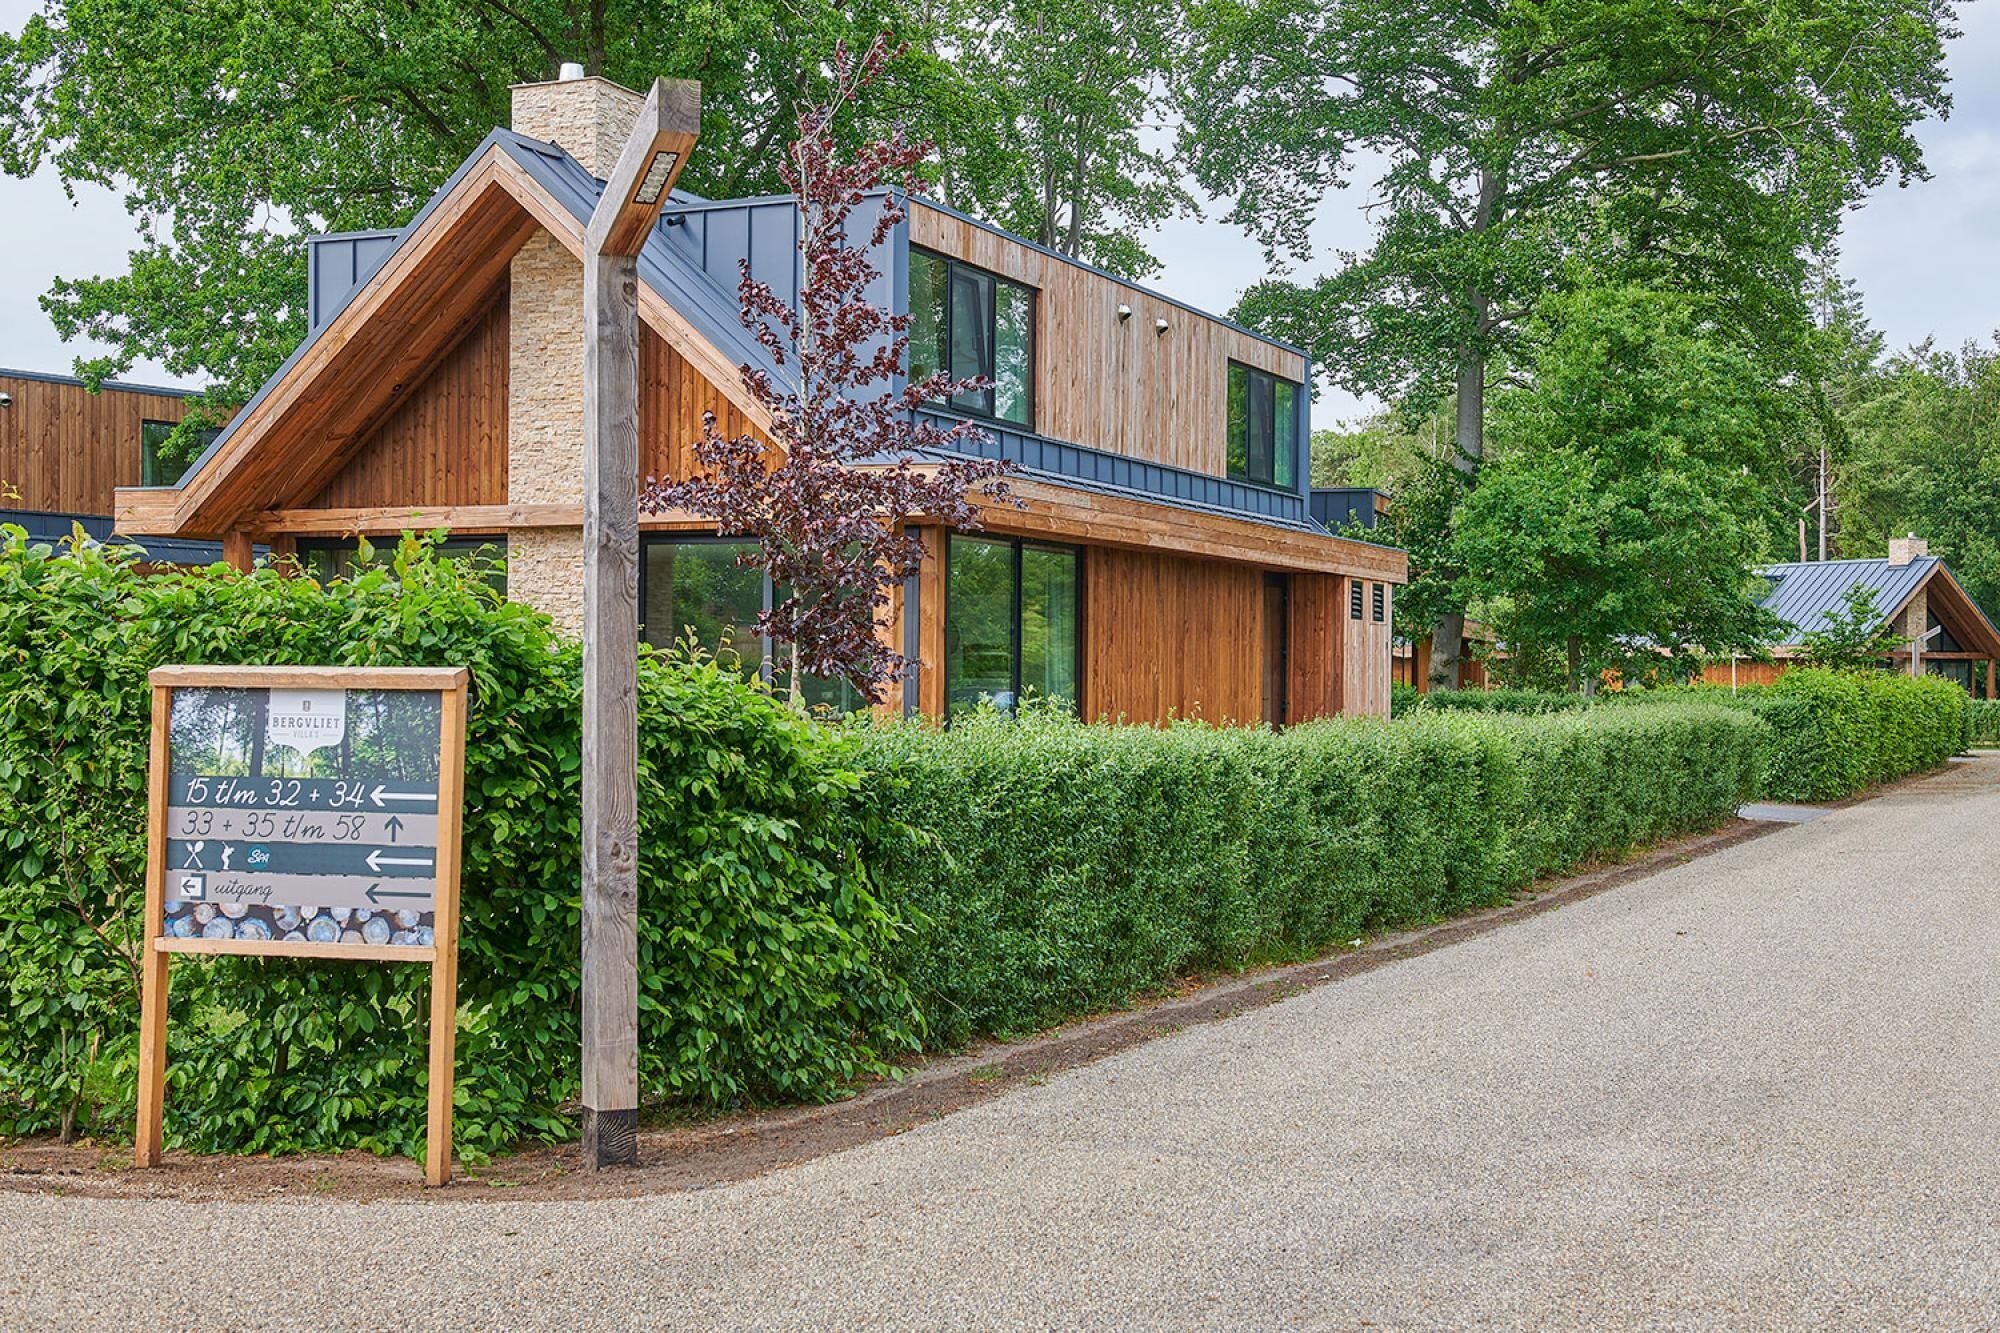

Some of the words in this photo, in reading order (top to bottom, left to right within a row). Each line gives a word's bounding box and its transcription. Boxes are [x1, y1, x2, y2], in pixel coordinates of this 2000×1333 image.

[272, 716, 341, 728] BERGVLIET
[186, 778, 210, 803] 15
[264, 779, 301, 806] 32
[309, 788, 320, 802] +
[328, 781, 365, 808] 34
[182, 810, 213, 835] 33
[223, 819, 232, 832] +
[242, 811, 276, 837] 35
[332, 815, 366, 840] 58
[214, 879, 273, 903] uitgang
